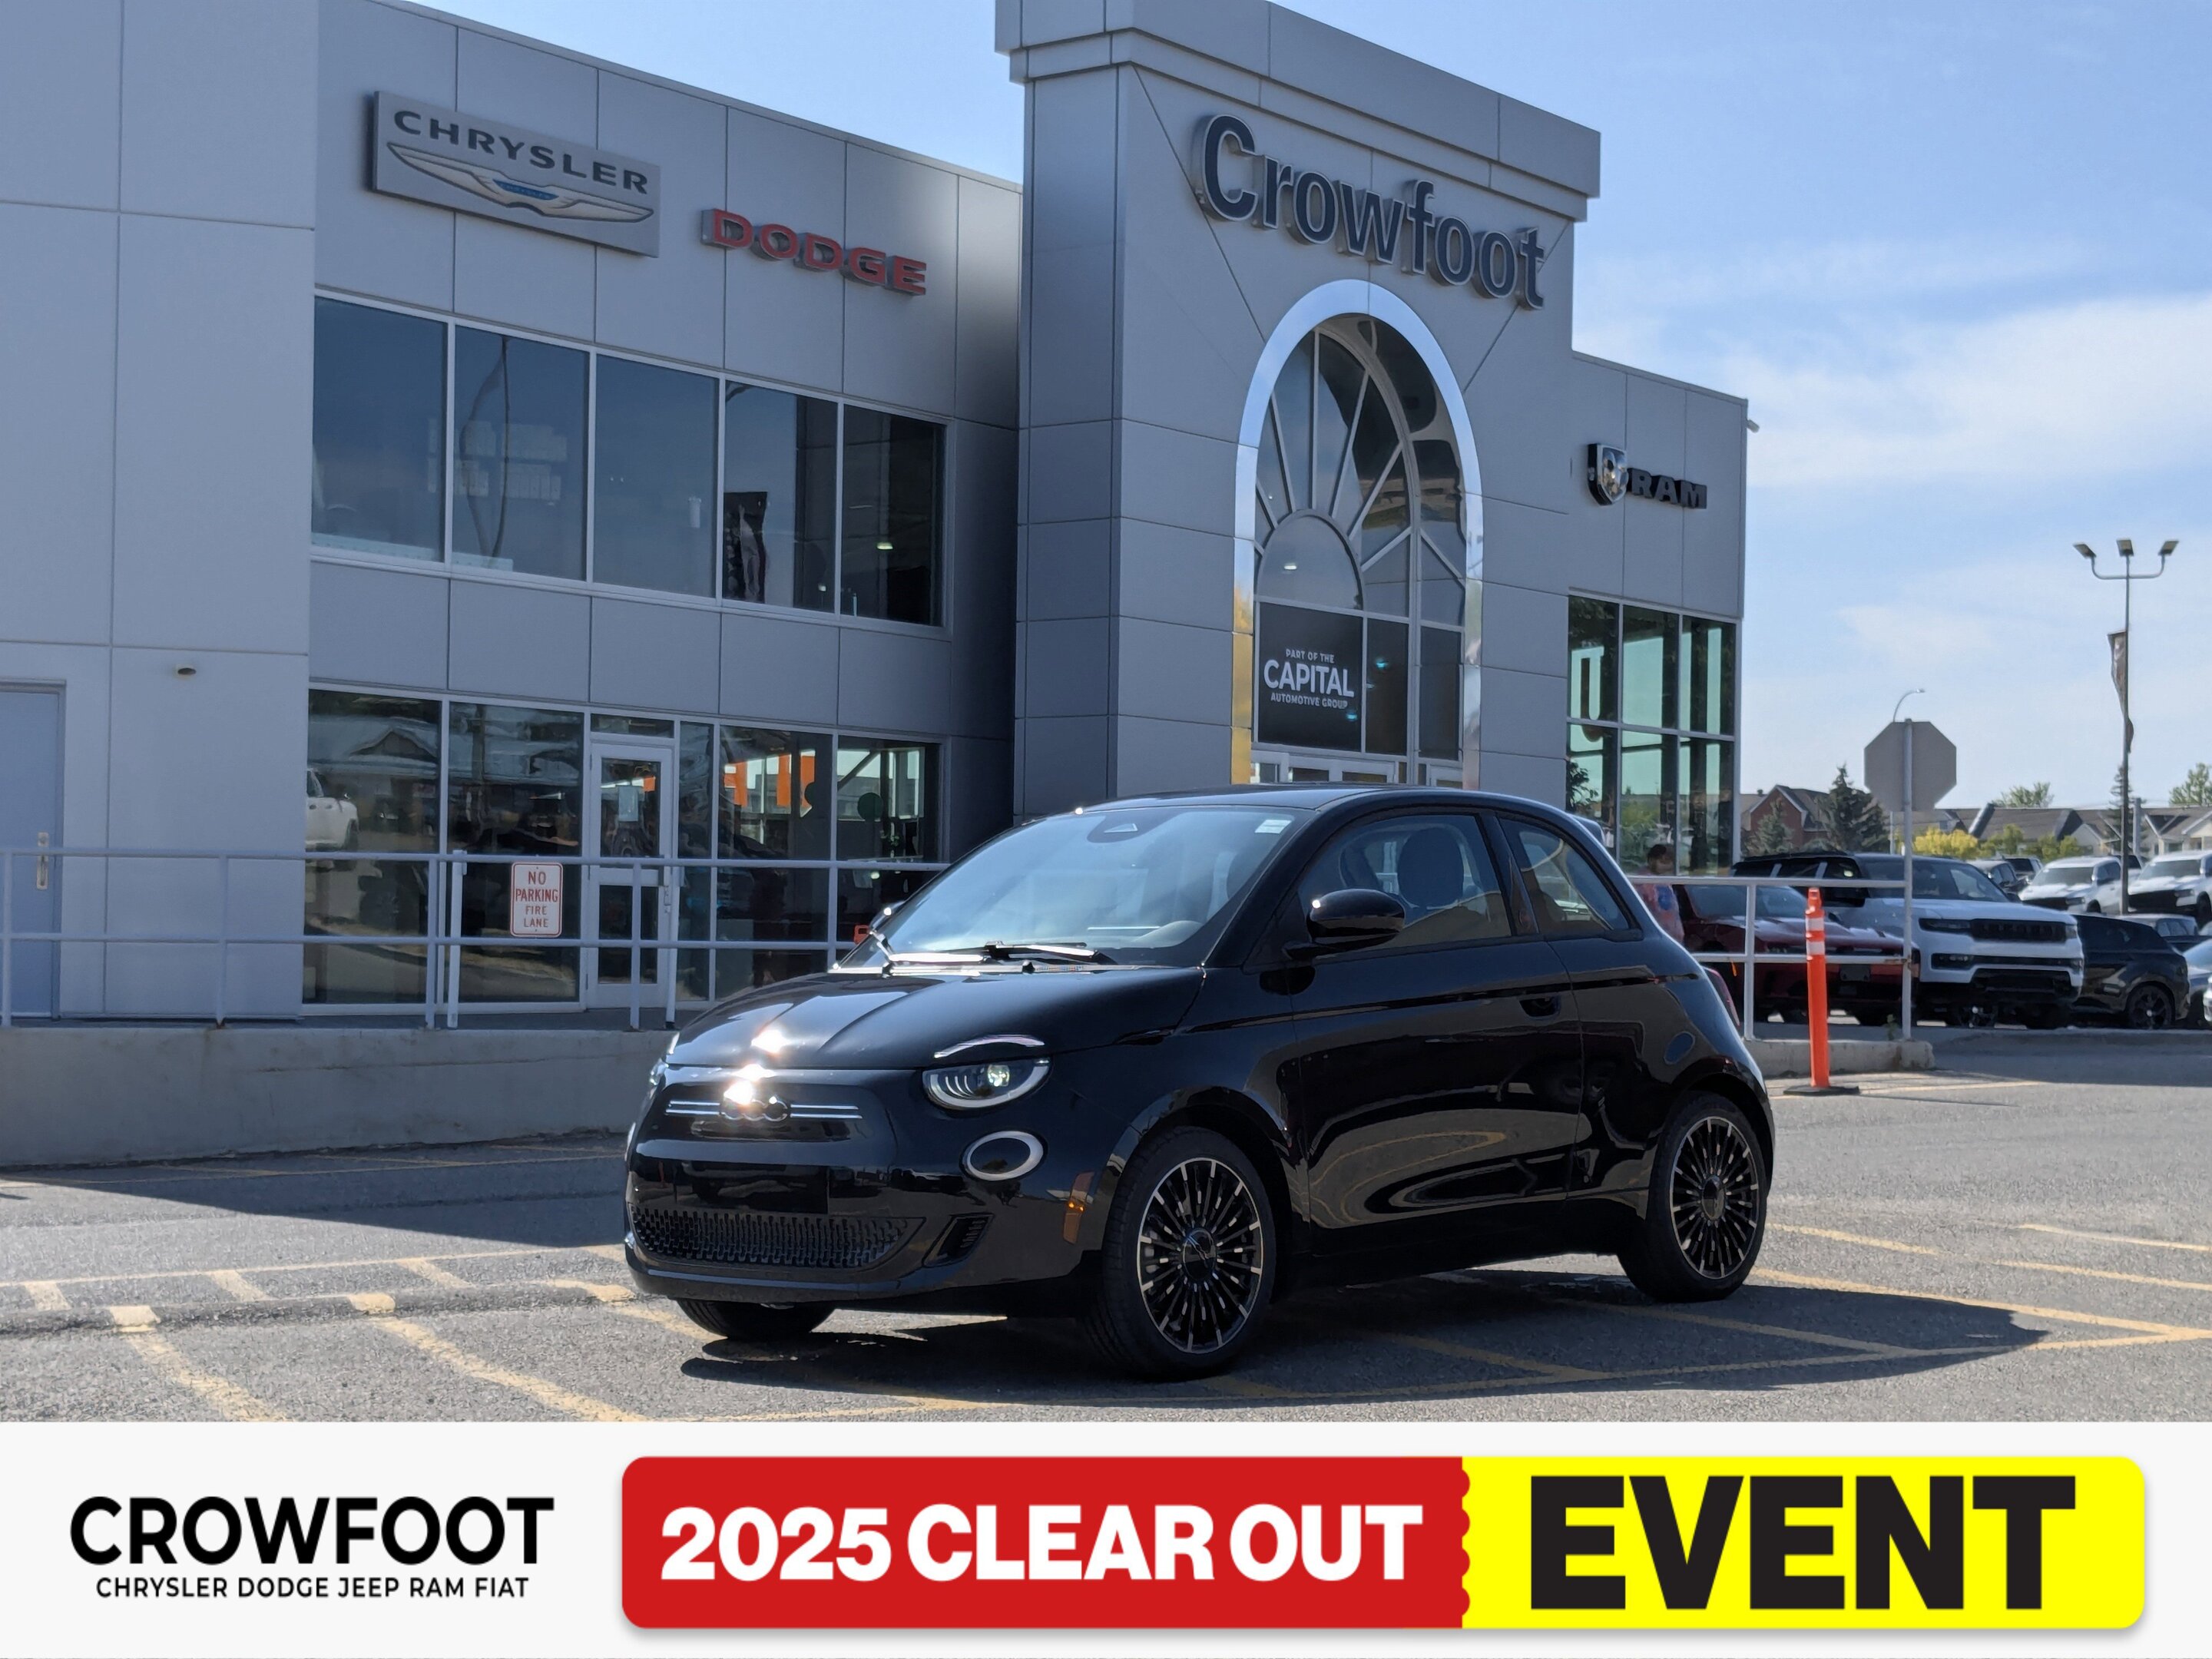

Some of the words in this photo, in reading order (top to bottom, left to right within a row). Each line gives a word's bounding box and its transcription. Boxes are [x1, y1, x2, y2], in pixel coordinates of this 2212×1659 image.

[393, 110, 648, 194] CHRYSLER
[1198, 114, 1545, 311] Crowfoot
[704, 207, 927, 296] DODGE
[1630, 468, 1707, 509] RAM
[1285, 648, 1306, 660] PART
[1307, 651, 1319, 661] OF
[1320, 653, 1335, 664] THE
[1263, 659, 1355, 697] CAPITAL
[1270, 693, 1320, 707] AUTOMOTIVE
[1321, 698, 1349, 709] GROUP
[528, 871, 546, 885] NO
[515, 889, 558, 902] PARKING
[525, 906, 548, 916] FIRE
[524, 918, 549, 928] LANE
